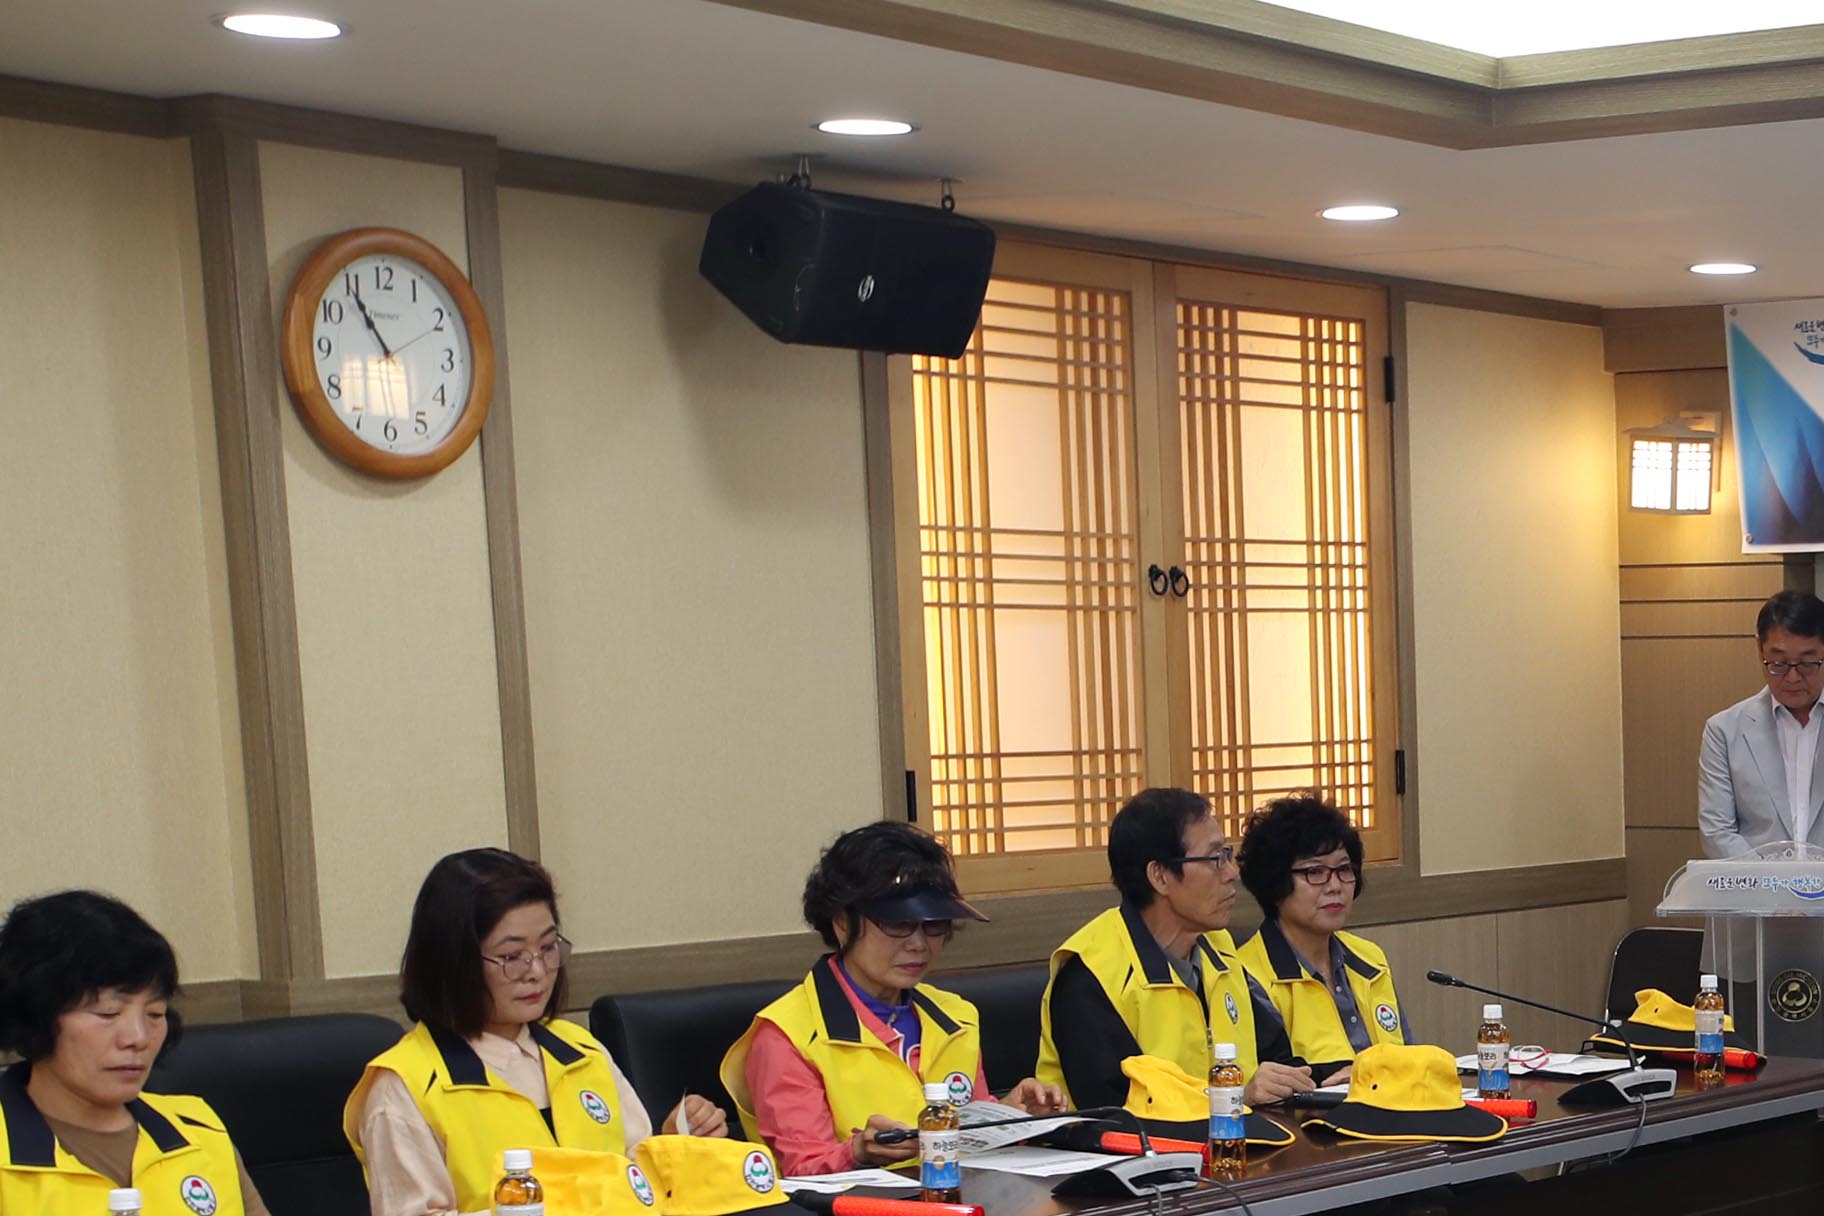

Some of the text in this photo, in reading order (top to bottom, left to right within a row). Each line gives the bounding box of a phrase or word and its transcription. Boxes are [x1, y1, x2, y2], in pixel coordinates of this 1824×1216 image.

[374, 266, 394, 291] 12
[410, 279, 418, 303] 1
[321, 299, 344, 325] 10
[431, 307, 445, 332] 2
[317, 336, 332, 361] 9
[440, 349, 455, 374] 3
[326, 373, 342, 401] 8
[432, 383, 447, 408] 4
[351, 405, 365, 431] 7
[383, 418, 398, 443] 6
[414, 410, 428, 436] 5
